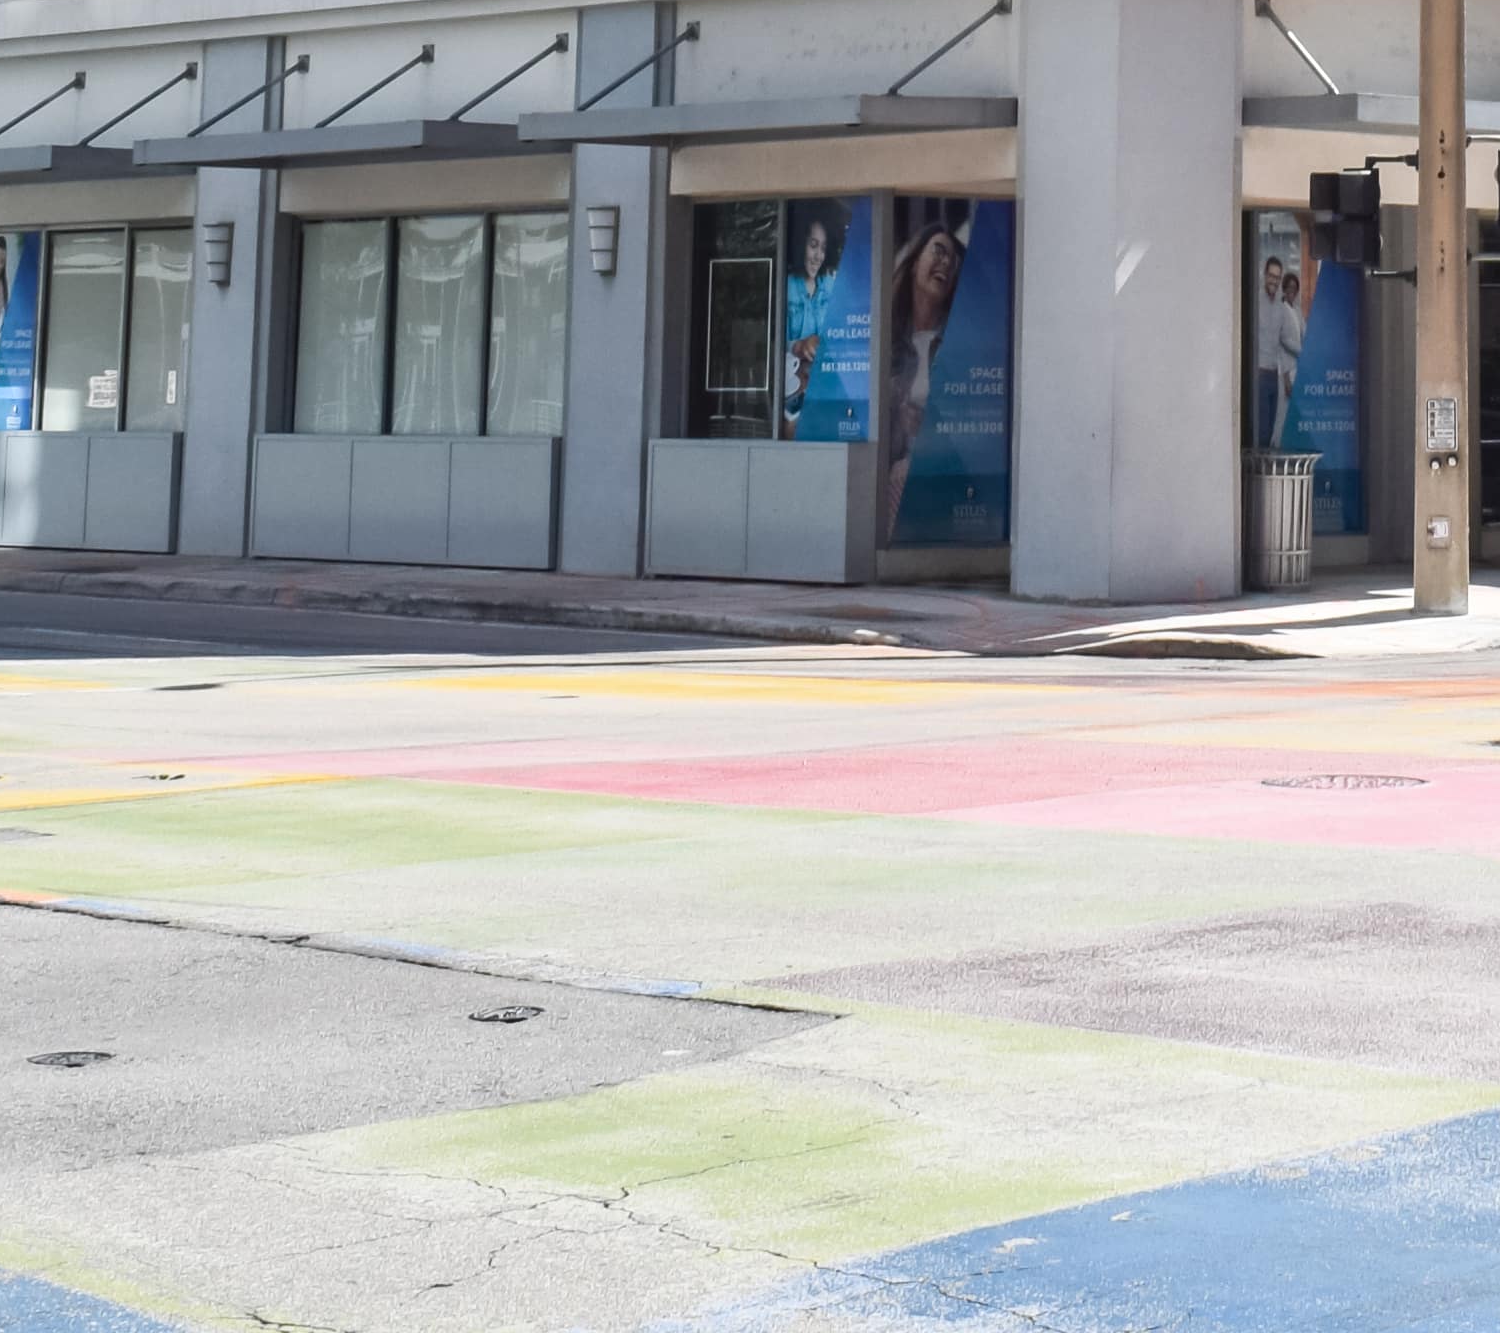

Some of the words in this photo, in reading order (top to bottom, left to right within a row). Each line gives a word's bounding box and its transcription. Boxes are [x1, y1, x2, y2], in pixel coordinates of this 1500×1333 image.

[827, 328, 844, 338] FOR
[969, 367, 1004, 379] SPACE
[1326, 370, 1356, 381] SPACE
[944, 383, 966, 395] FOR
[970, 383, 1004, 395] LEASE
[1304, 385, 1324, 396] FOR
[1326, 385, 1356, 396] LEASE
